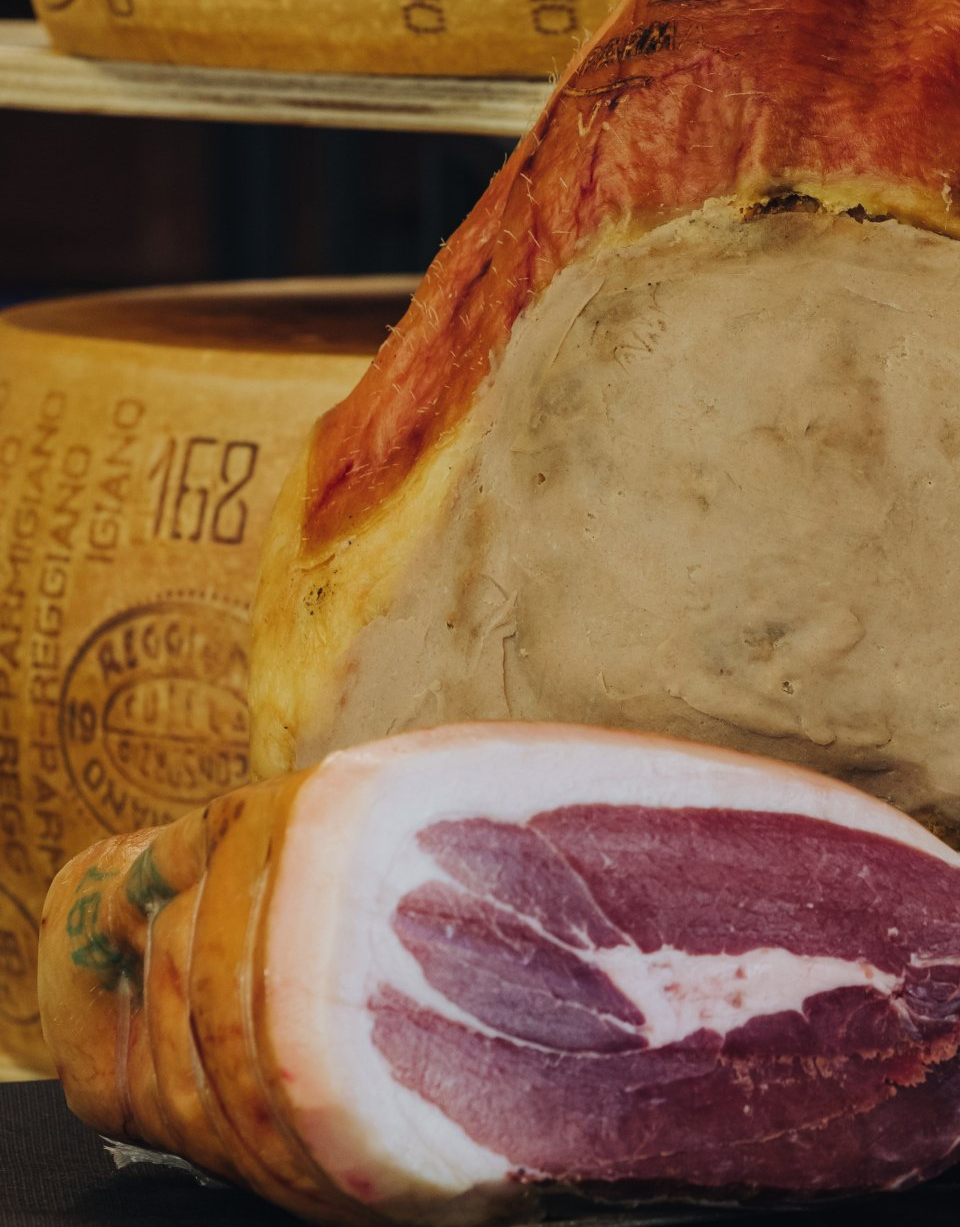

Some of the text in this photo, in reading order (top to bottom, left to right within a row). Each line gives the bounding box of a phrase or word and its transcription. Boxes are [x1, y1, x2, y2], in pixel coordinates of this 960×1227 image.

[85, 397, 147, 564] IGIANO
[149, 435, 260, 547] 168
[29, 444, 93, 707] REGGIANO
